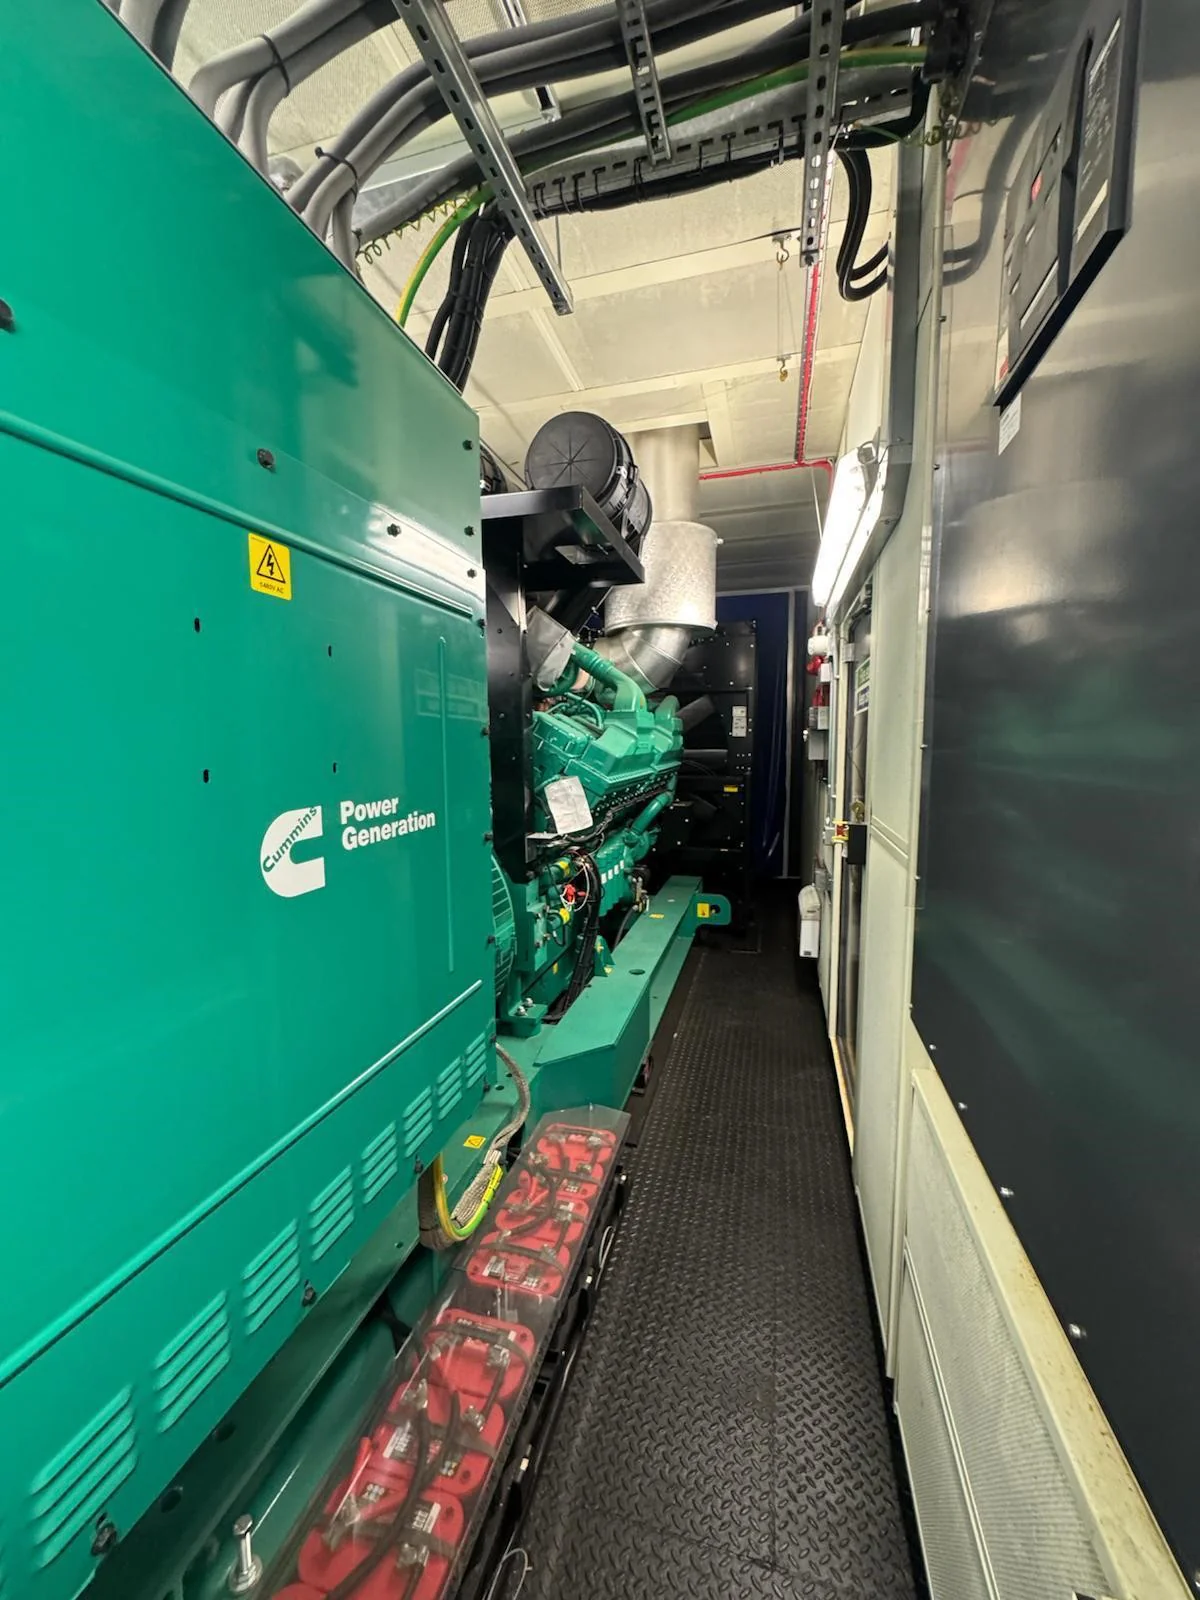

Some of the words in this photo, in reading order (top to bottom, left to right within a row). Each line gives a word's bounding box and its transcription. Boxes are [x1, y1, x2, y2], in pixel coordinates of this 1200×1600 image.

[340, 797, 399, 825] Power
[342, 811, 436, 851] Generation
[262, 806, 318, 873] Cummins
